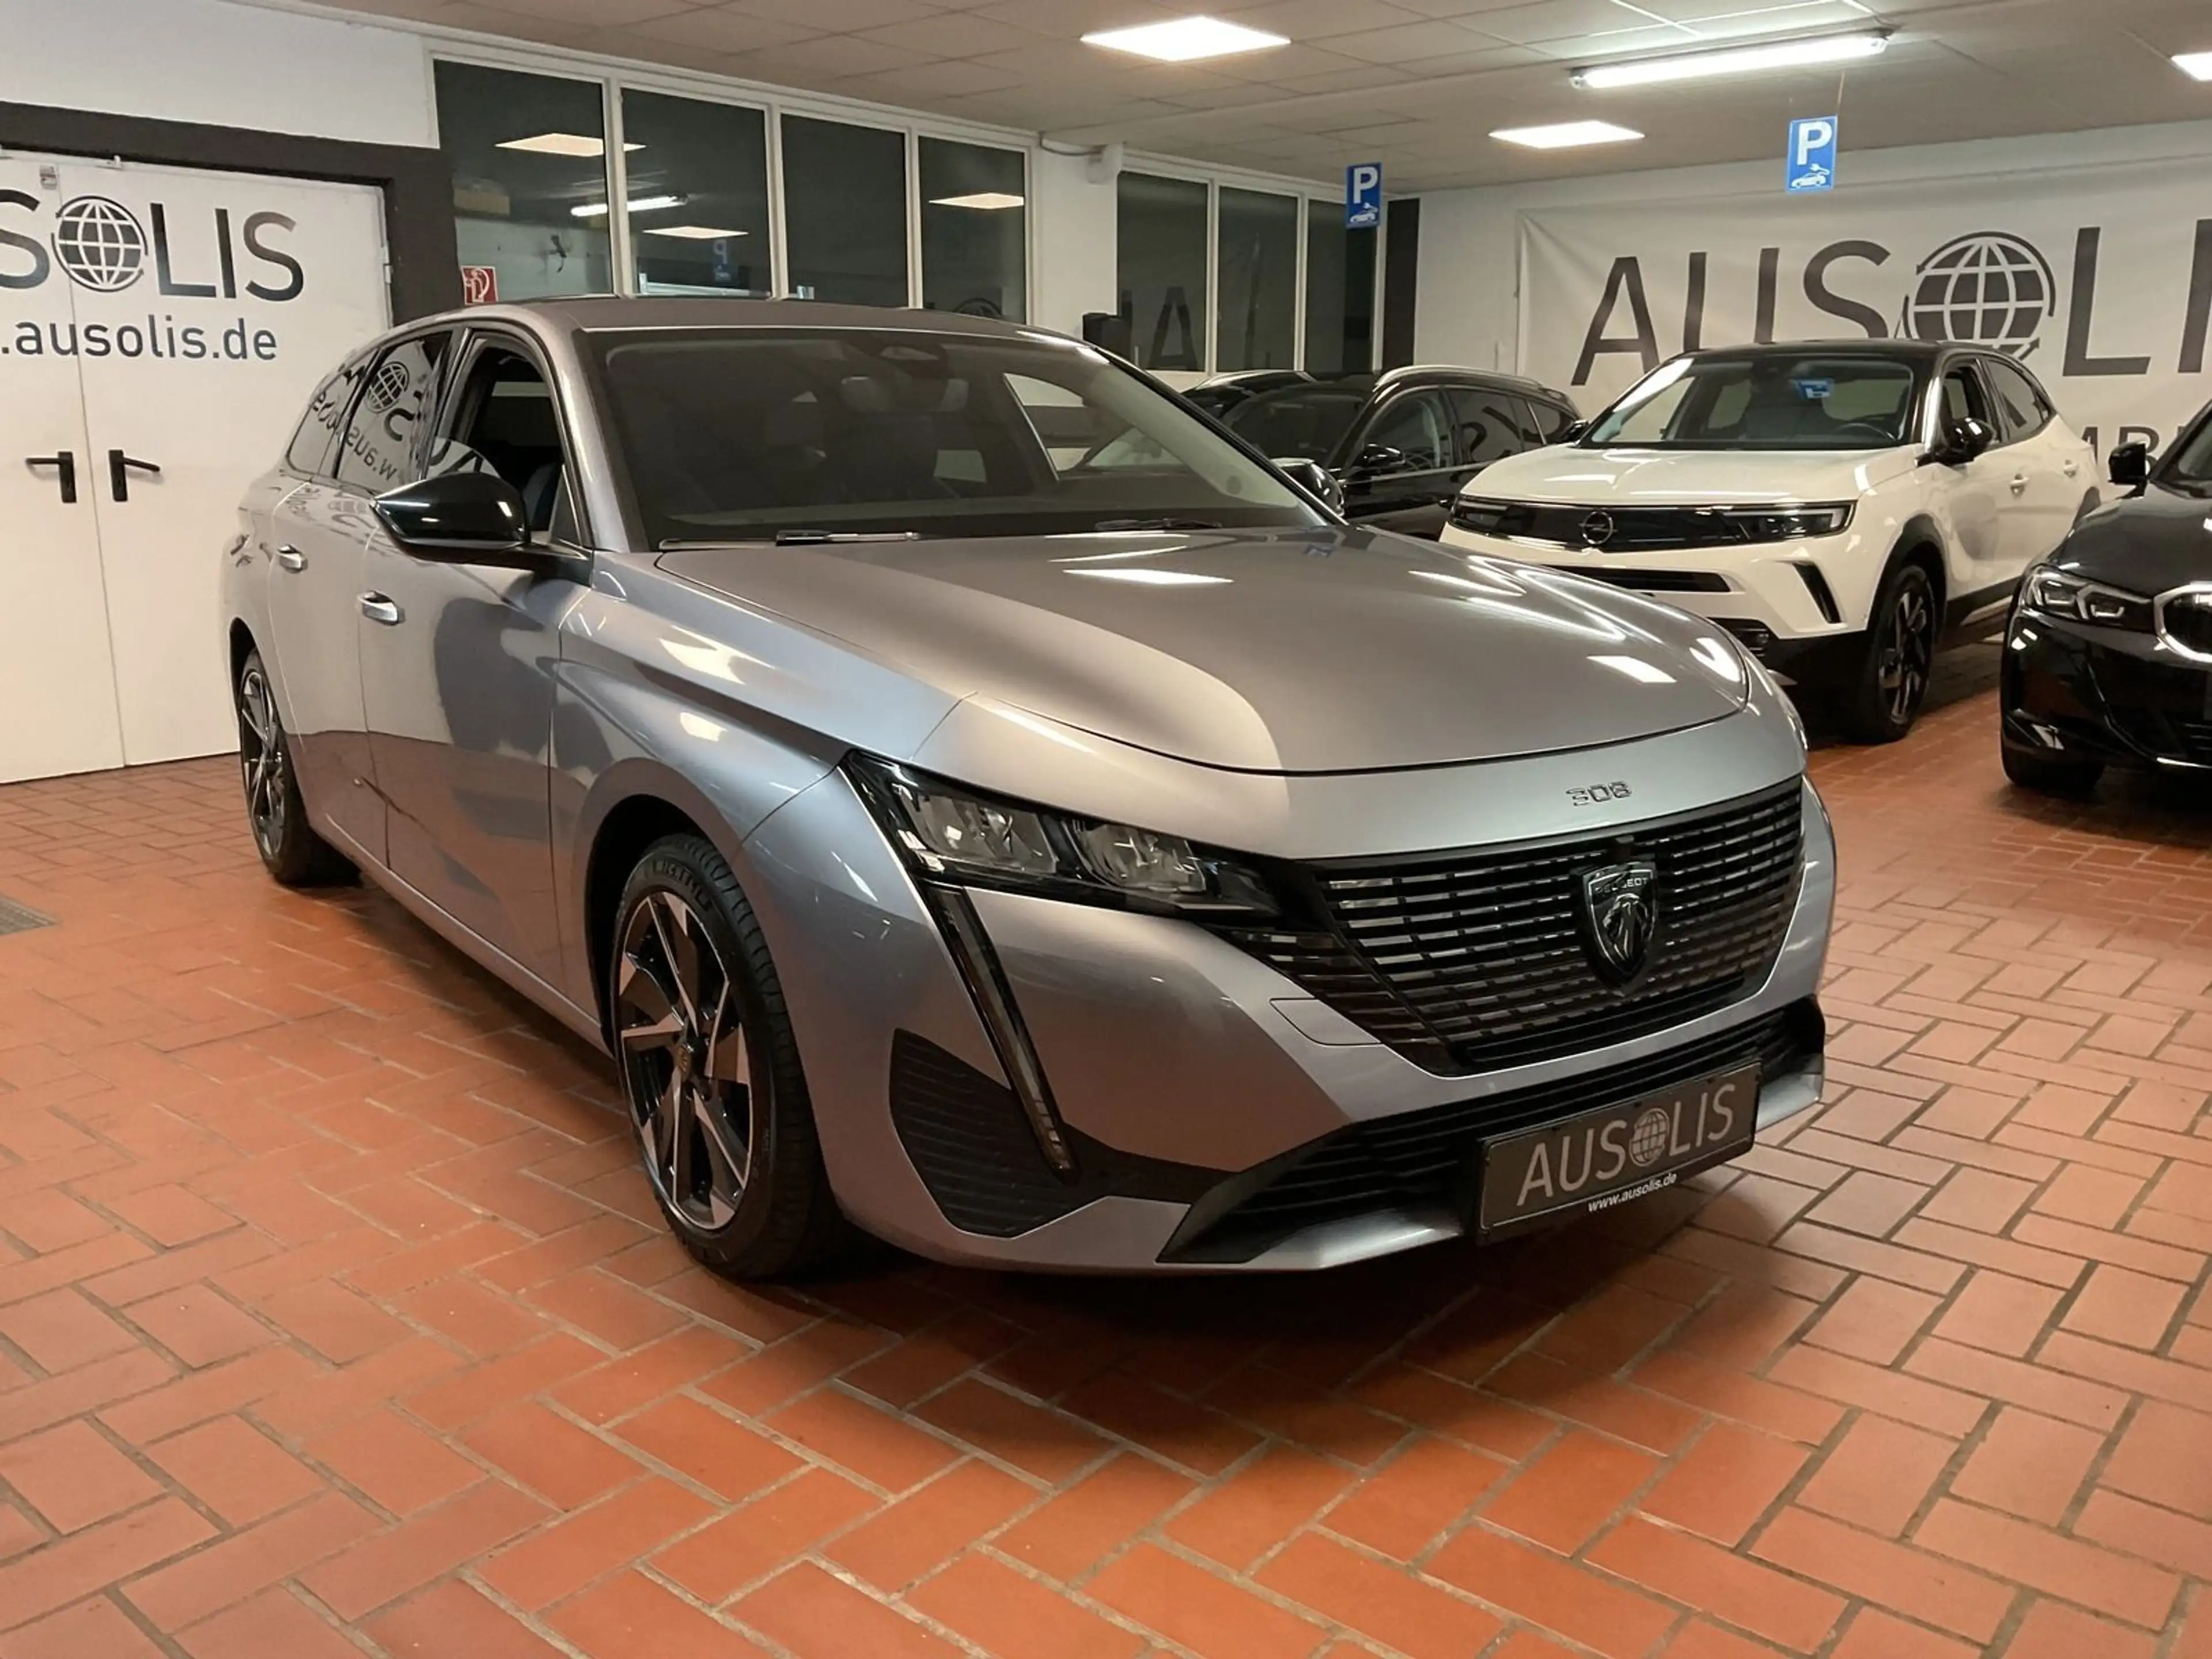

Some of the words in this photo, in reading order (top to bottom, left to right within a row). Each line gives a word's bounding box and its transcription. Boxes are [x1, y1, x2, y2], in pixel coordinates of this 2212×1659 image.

[1797, 121, 1832, 165] P
[1353, 166, 1377, 204] P
[1566, 781, 1632, 806] 308
[1516, 1083, 1736, 1207] AUSOLIS
[1588, 1172, 1677, 1213] www.ausolis.de
